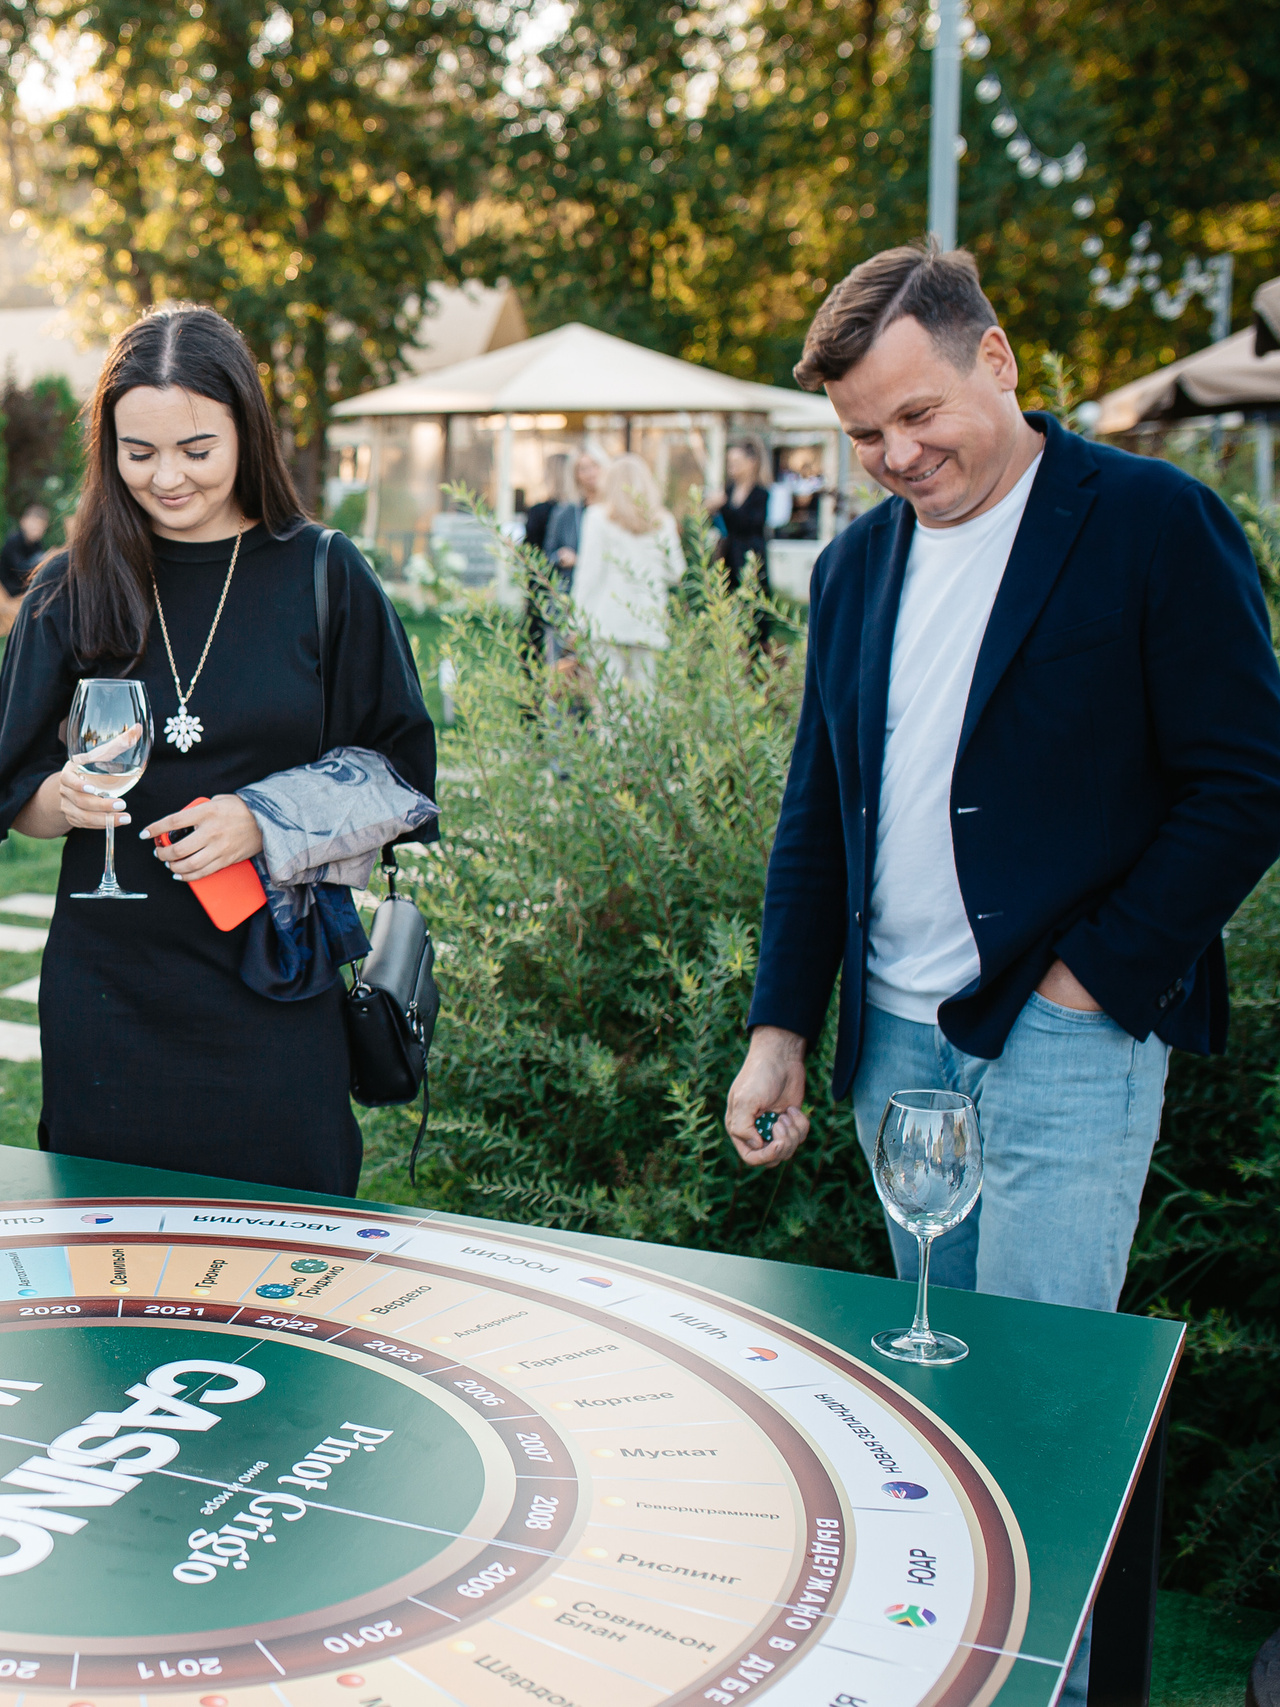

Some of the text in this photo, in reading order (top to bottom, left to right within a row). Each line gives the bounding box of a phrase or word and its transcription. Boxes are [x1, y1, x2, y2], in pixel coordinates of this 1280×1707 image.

[193, 1215, 342, 1232] АВСТРАЛИЯ
[110, 1248, 128, 1285] Семильон
[194, 1258, 228, 1289] Грюнер
[460, 1246, 560, 1274] РОССИЯ
[297, 1265, 345, 1299] Гриджио
[19, 1305, 81, 1316] 2020
[144, 1305, 205, 1316] 2021
[370, 1284, 432, 1316] Вердехо
[254, 1315, 319, 1332] 2022
[454, 1310, 529, 1339] Альбариньо
[669, 1312, 728, 1340] ЧИЛИ
[363, 1340, 424, 1362] 2023
[517, 1343, 620, 1370] Гарганега
[454, 1379, 505, 1407] 2006
[573, 1391, 675, 1409] Кортезе
[516, 1432, 554, 1463] 2007
[813, 1393, 902, 1473] НОВАЯ ЗЕЛАНДИЯ
[620, 1448, 719, 1460] Мускат
[172, 1421, 394, 1584] Pinot Grigio
[525, 1494, 559, 1530] 2008
[636, 1501, 780, 1521] Гевюрцтраминер
[457, 1561, 516, 1598] 2009
[617, 1553, 742, 1586] Рислинг
[907, 1549, 937, 1586] ЮАР
[572, 1601, 718, 1653] Совиньон
[703, 1517, 840, 1706] ВЫДЕРЖАНО В ДУБЕ
[323, 1619, 403, 1653] 2010
[554, 1612, 628, 1643] Блан
[137, 1657, 223, 1680] 2011
